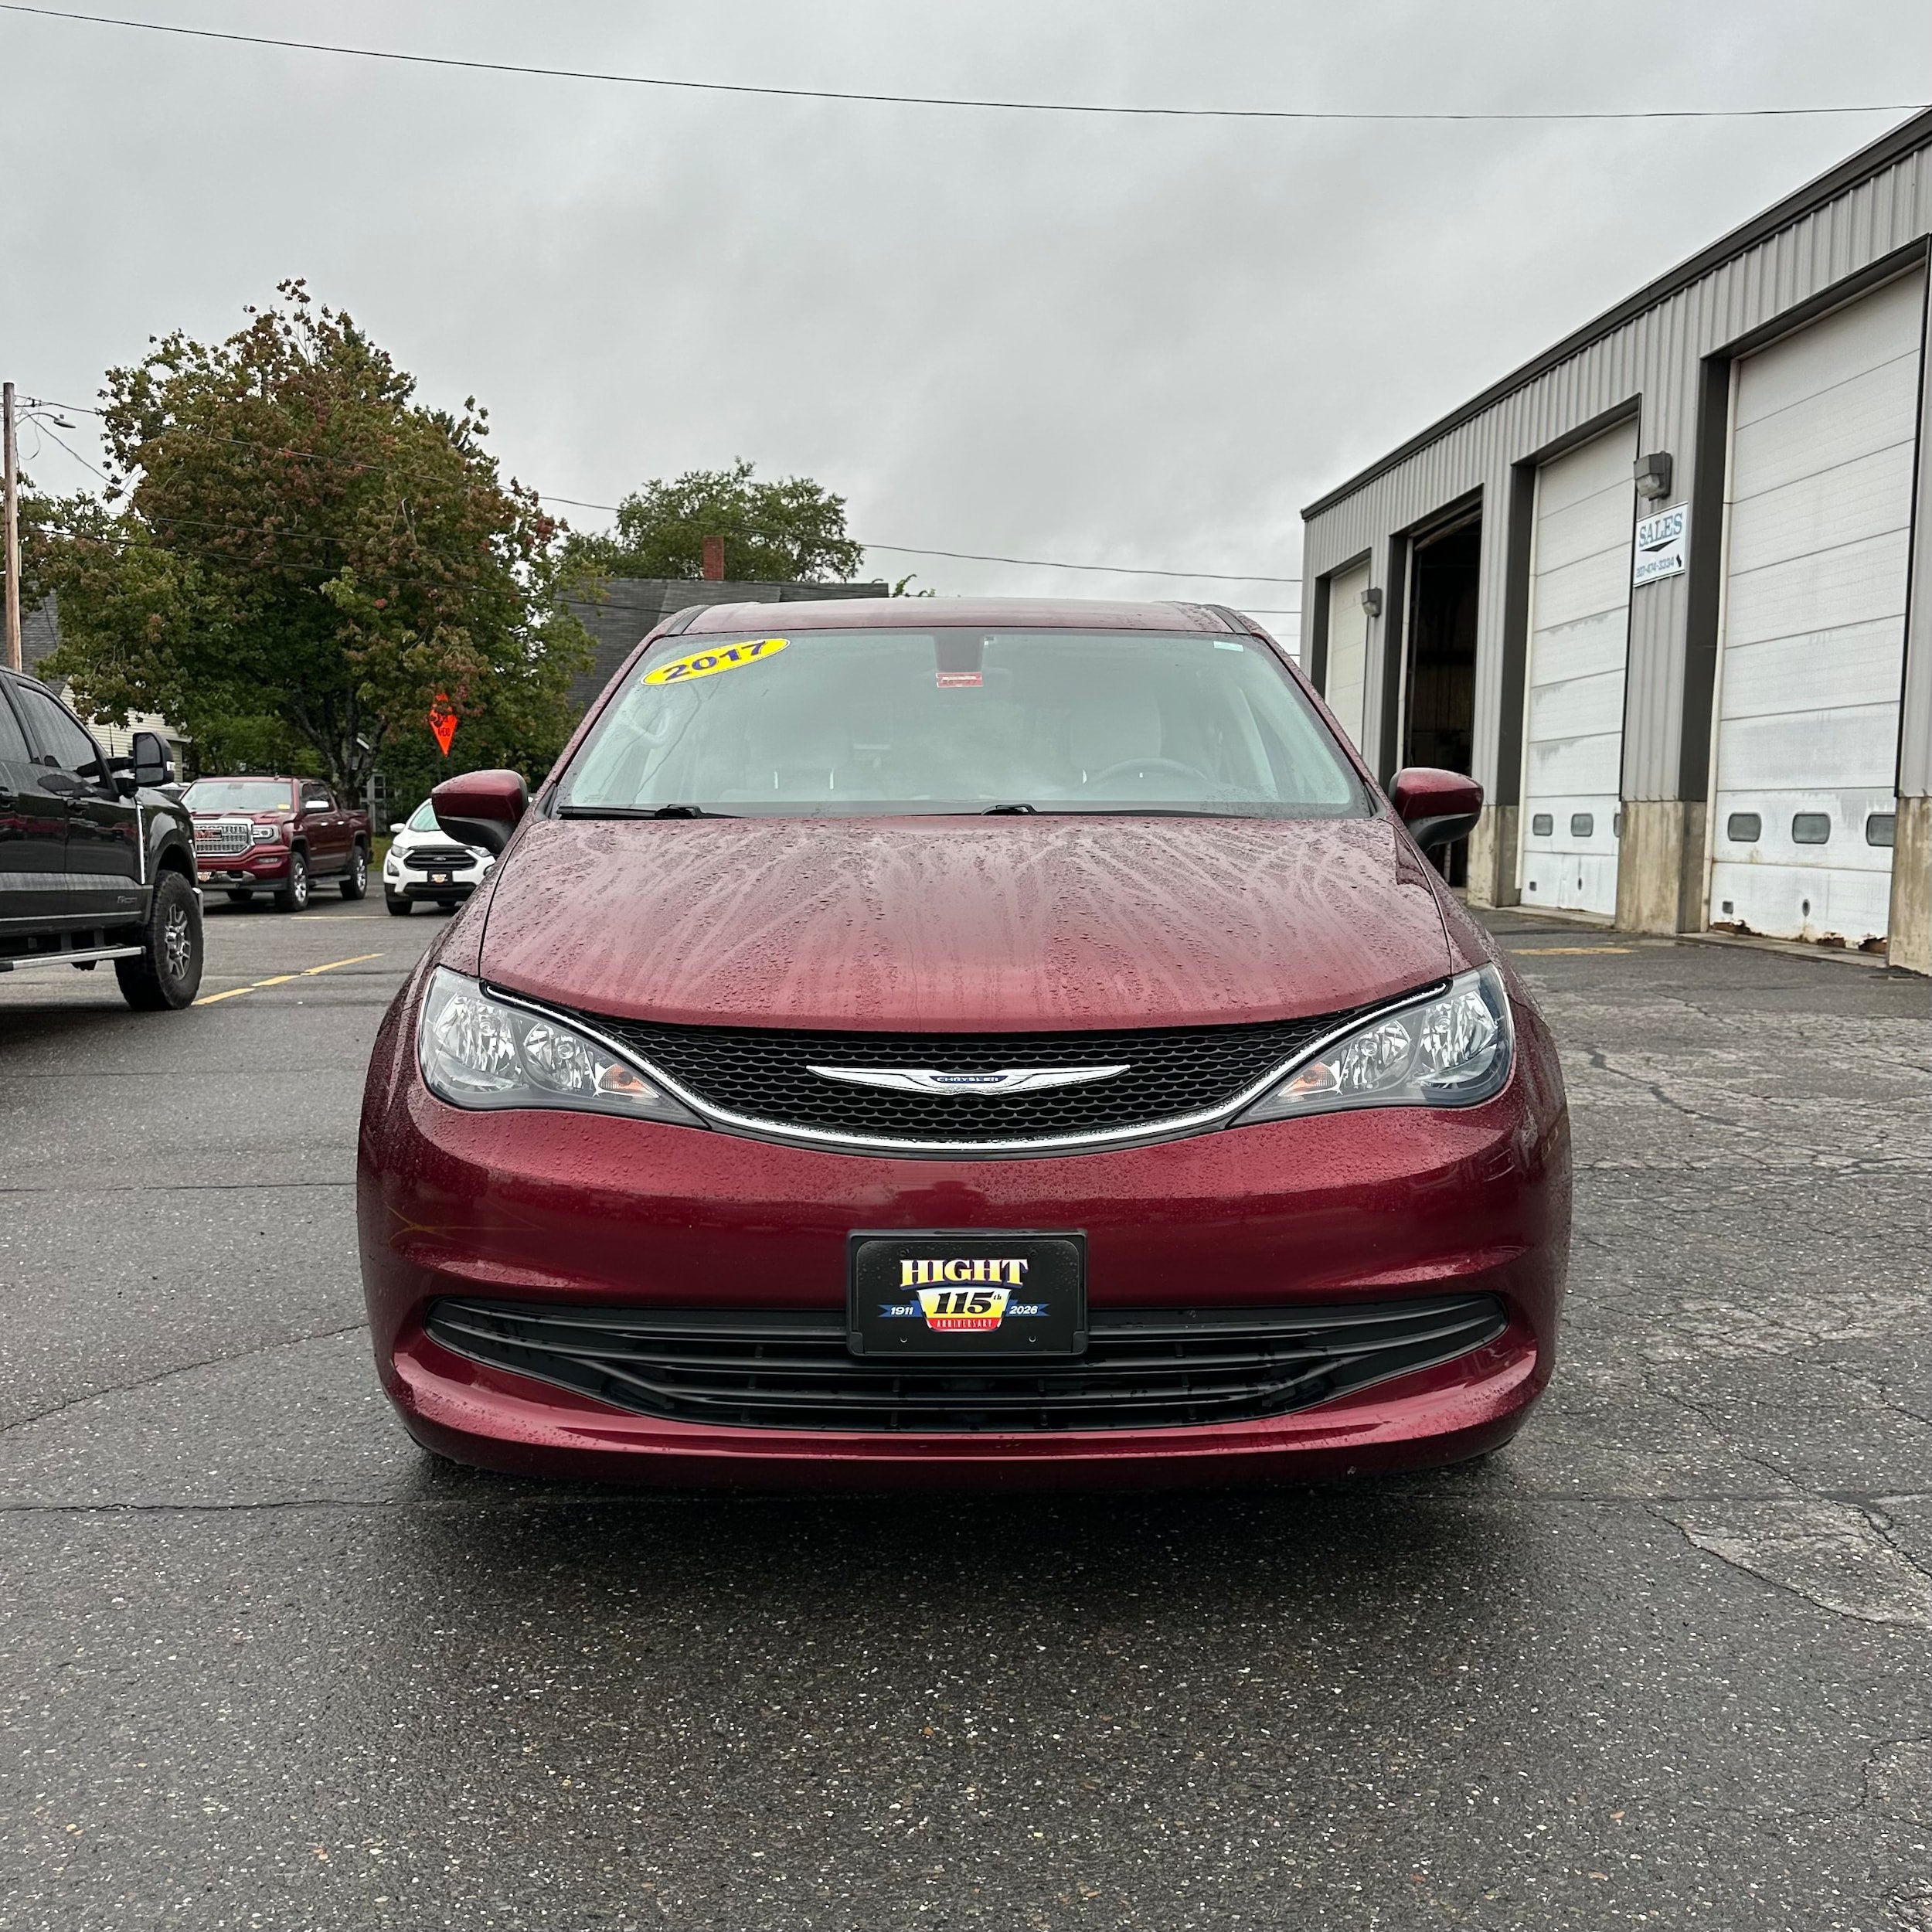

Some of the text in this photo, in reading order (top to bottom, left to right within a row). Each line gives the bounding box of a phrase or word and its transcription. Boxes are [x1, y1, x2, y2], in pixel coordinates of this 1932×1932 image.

[1638, 512, 1683, 547] SALES
[663, 640, 767, 682] 2017
[194, 830, 222, 838] MC
[900, 1259, 1029, 1289] HIGHT
[890, 1306, 914, 1315] 1911
[1009, 1305, 1039, 1315] 2026
[936, 1318, 993, 1328] ANNIVERSARY
